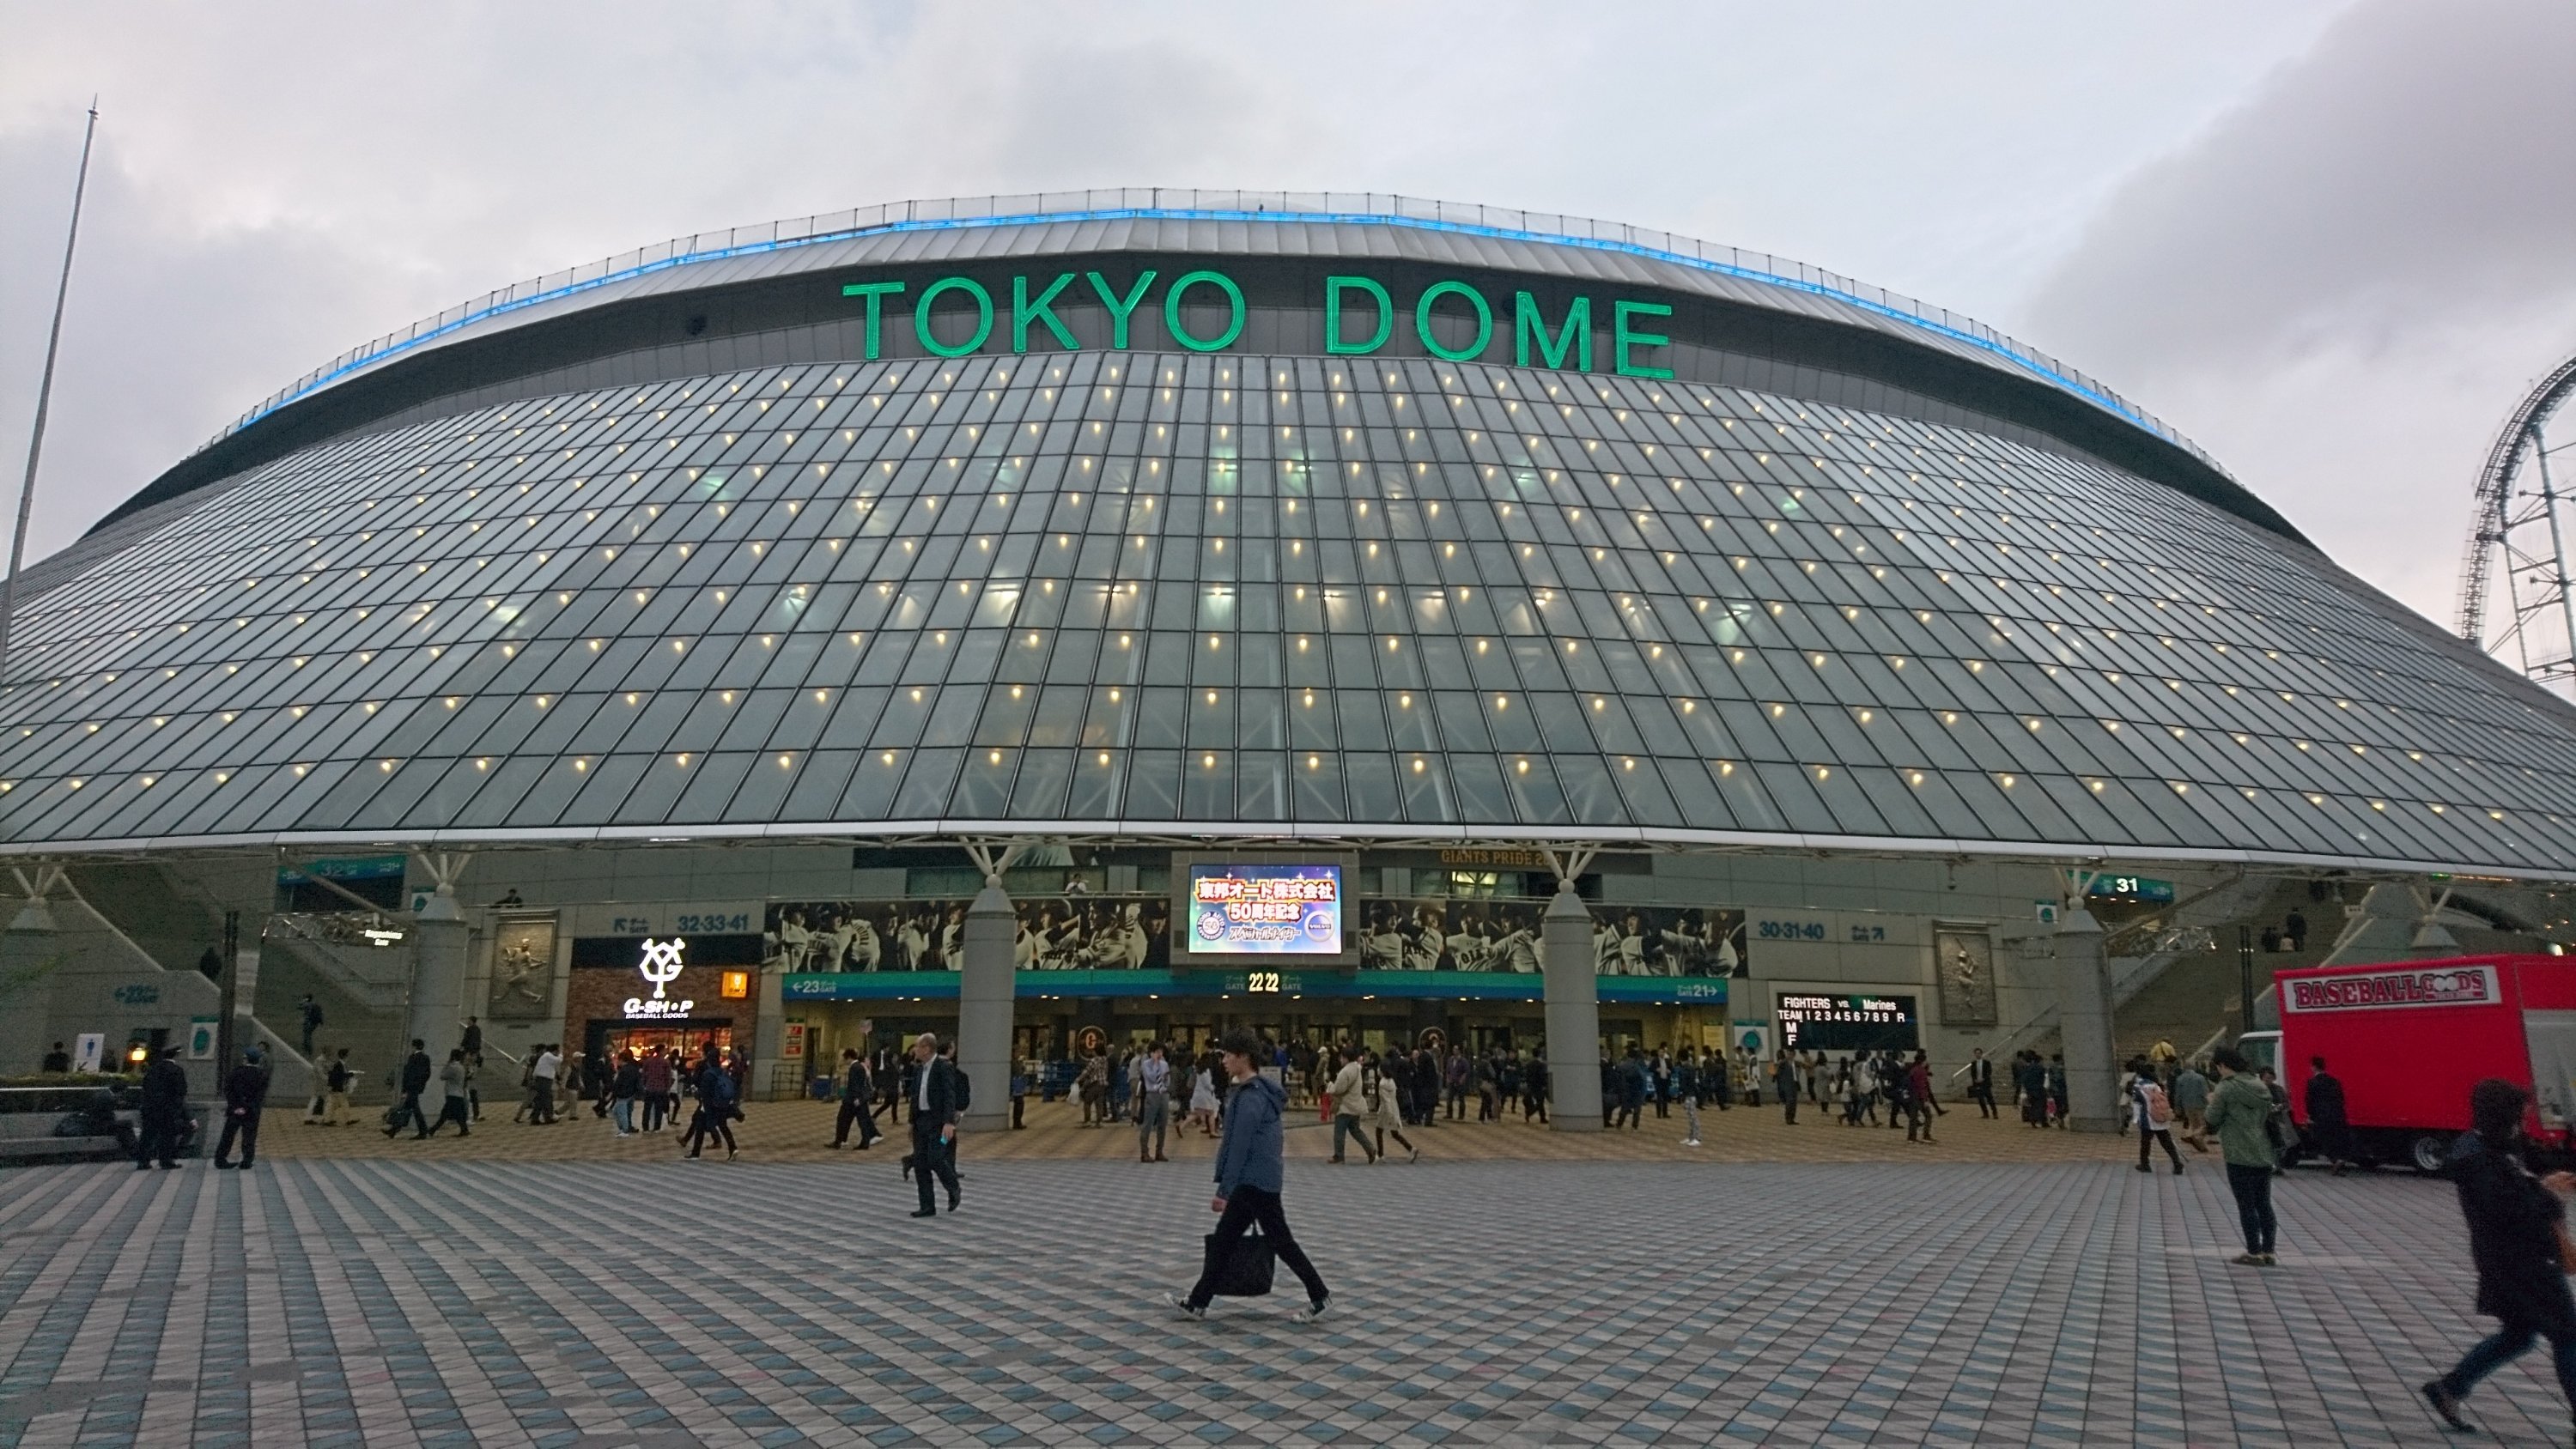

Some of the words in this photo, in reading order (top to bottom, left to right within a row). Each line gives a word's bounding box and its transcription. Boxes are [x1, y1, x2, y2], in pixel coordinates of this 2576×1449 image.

[842, 270, 1246, 360] TOKYO
[1326, 276, 1675, 379] DOME
[1441, 849, 1489, 864] GIANTS
[1492, 852, 1532, 865] PRIDE
[1535, 852, 1563, 866] 28
[1199, 881, 1334, 900] 東邦オート株式会社
[2117, 877, 2138, 893] 31
[1230, 902, 1302, 921] 50周年記念
[1230, 926, 1302, 941] スペシャルナイター
[802, 980, 820, 994] 23
[1693, 984, 1709, 997] 21
[2294, 974, 2421, 1008] BASEBALL
[1783, 997, 1831, 1009] FIGHTERS
[1862, 998, 1896, 1011] Marines
[1777, 1009, 1802, 1021] TEAM
[1806, 1009, 1810, 1020] 1
[1814, 1010, 1821, 1021] 2
[1825, 1010, 1831, 1021] 3
[1834, 1010, 1842, 1021] 4
[1844, 1011, 1851, 1022] 5
[1854, 1011, 1860, 1022] 6
[1863, 1012, 1870, 1022] 7
[1873, 1012, 1880, 1022] 8
[1882, 1012, 1889, 1022] 9
[1896, 1012, 1905, 1022] R
[1786, 1022, 1797, 1034] M
[1787, 1034, 1796, 1046] F
